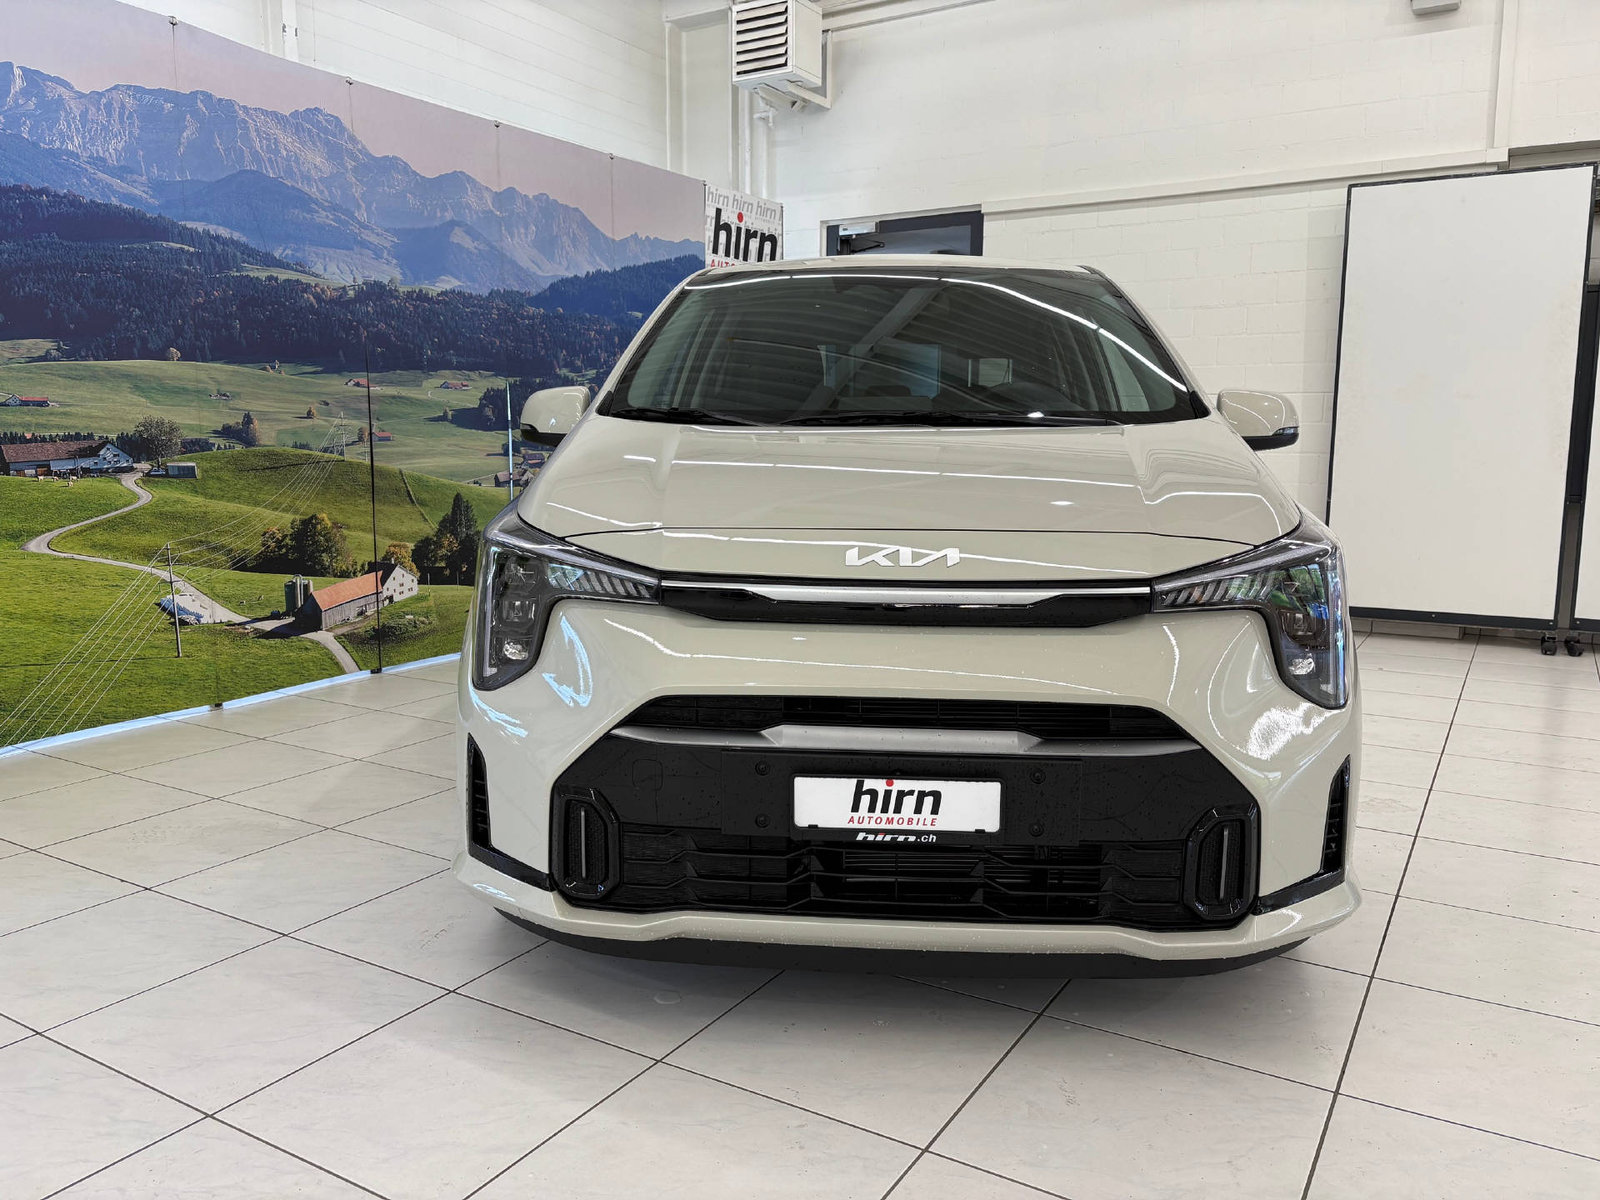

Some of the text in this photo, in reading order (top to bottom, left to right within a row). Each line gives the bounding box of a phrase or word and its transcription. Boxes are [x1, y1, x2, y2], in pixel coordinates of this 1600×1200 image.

[707, 186, 777, 219] hirn hirn hirn
[712, 207, 778, 262] hirn
[850, 779, 942, 815] hirn
[847, 815, 937, 827] AUTOMOBILE
[855, 832, 937, 843] hirn.ch
